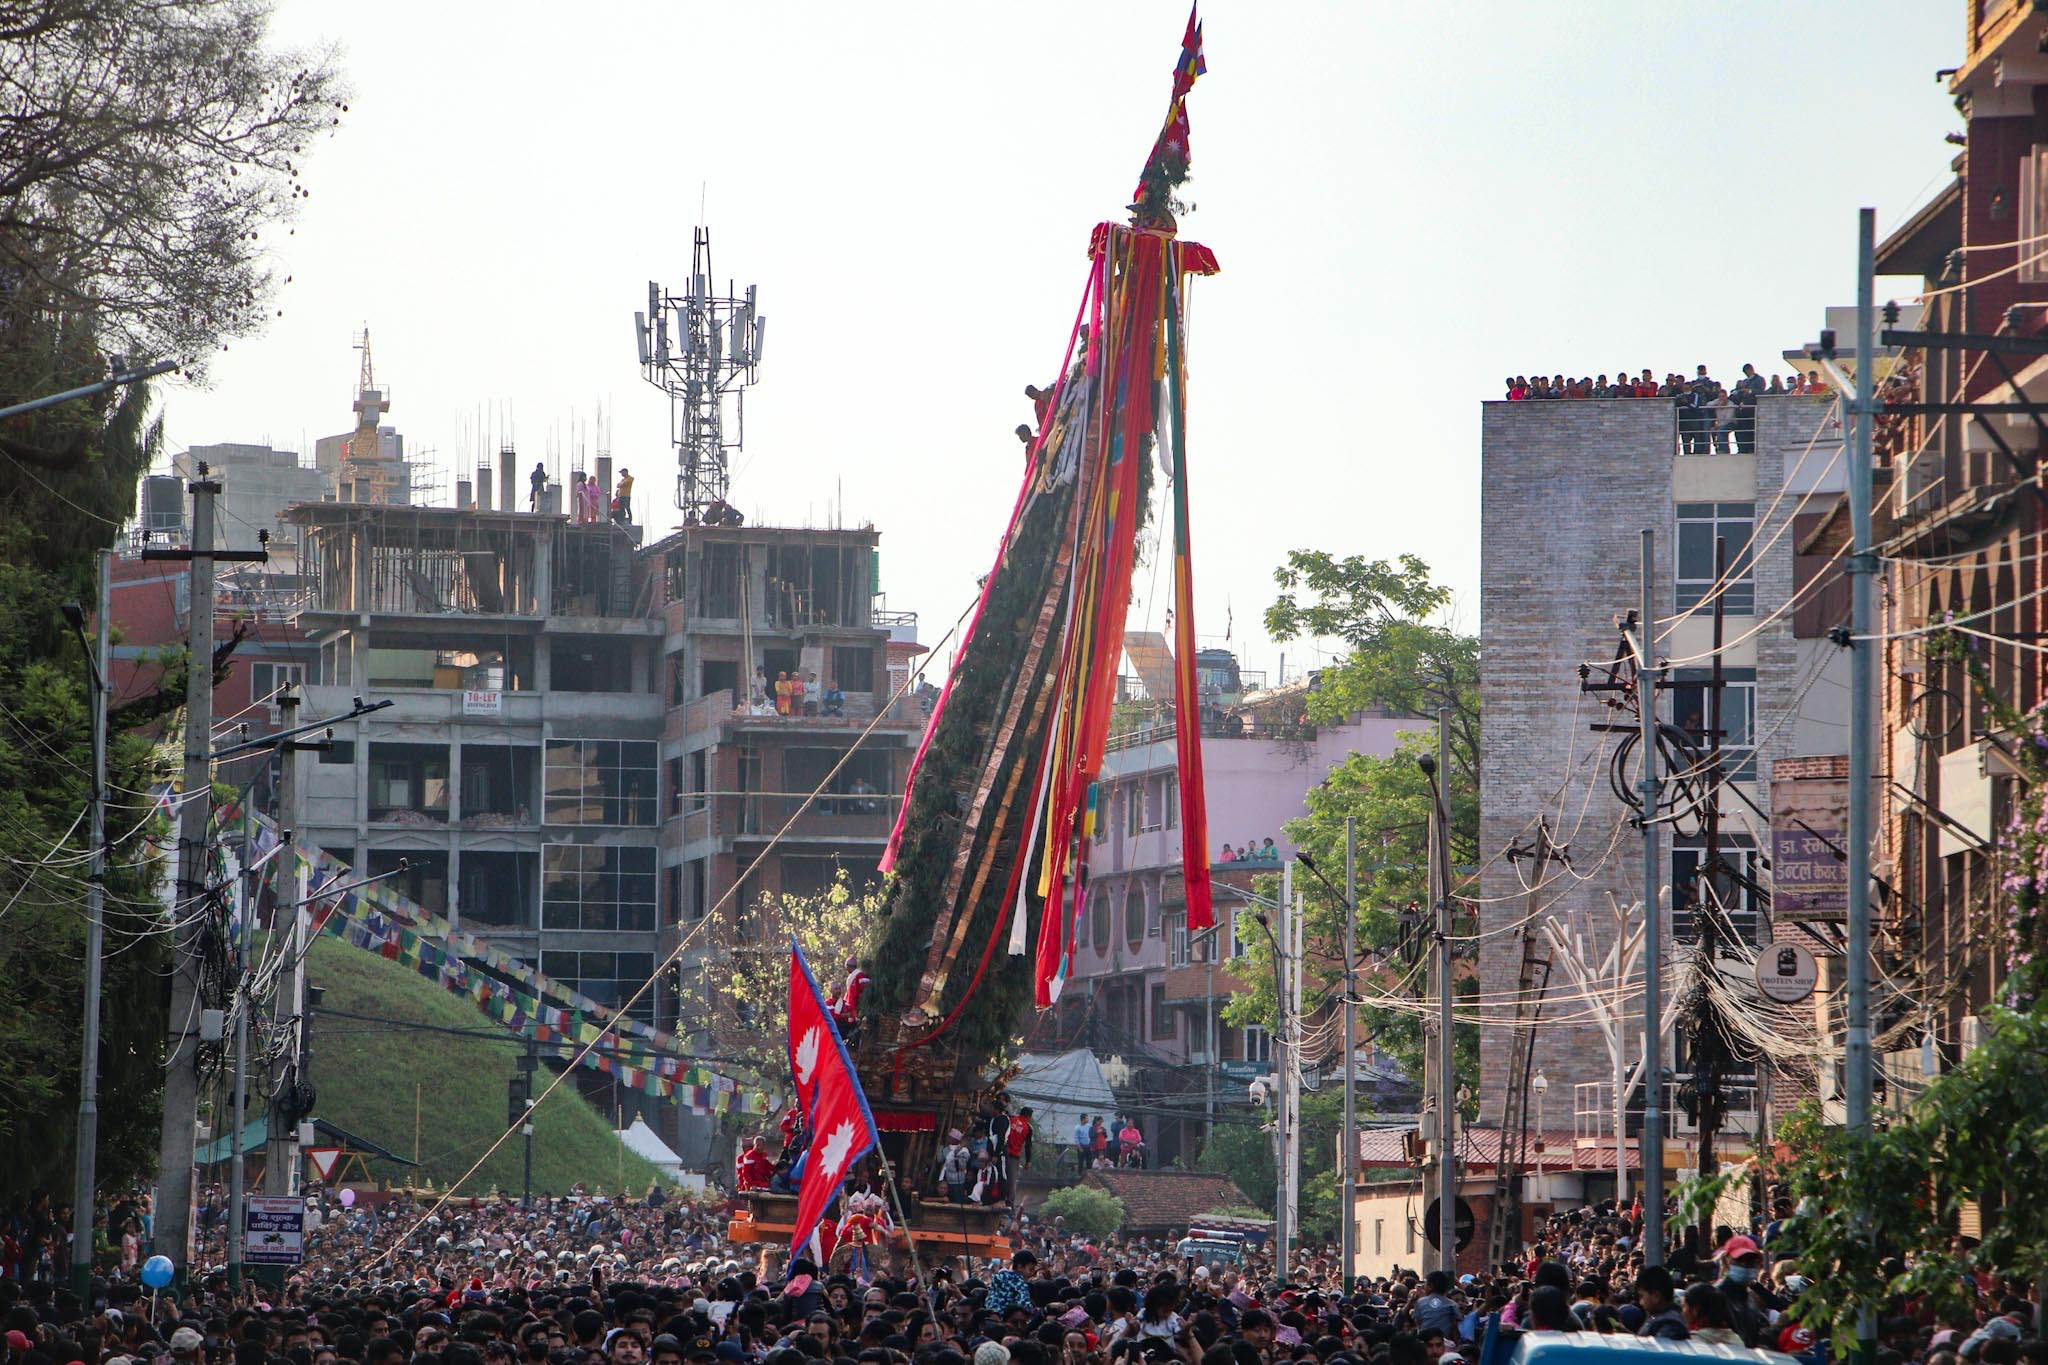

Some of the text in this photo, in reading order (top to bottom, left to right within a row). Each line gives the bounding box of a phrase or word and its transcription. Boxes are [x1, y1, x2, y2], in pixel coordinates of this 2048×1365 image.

[468, 692, 497, 702] TO-LET
[1780, 840, 1799, 854] डा.
[1776, 857, 1811, 880] डेन्टल
[1761, 977, 1793, 985] PROTEIN
[1213, 1248, 1239, 1256] POLIC
